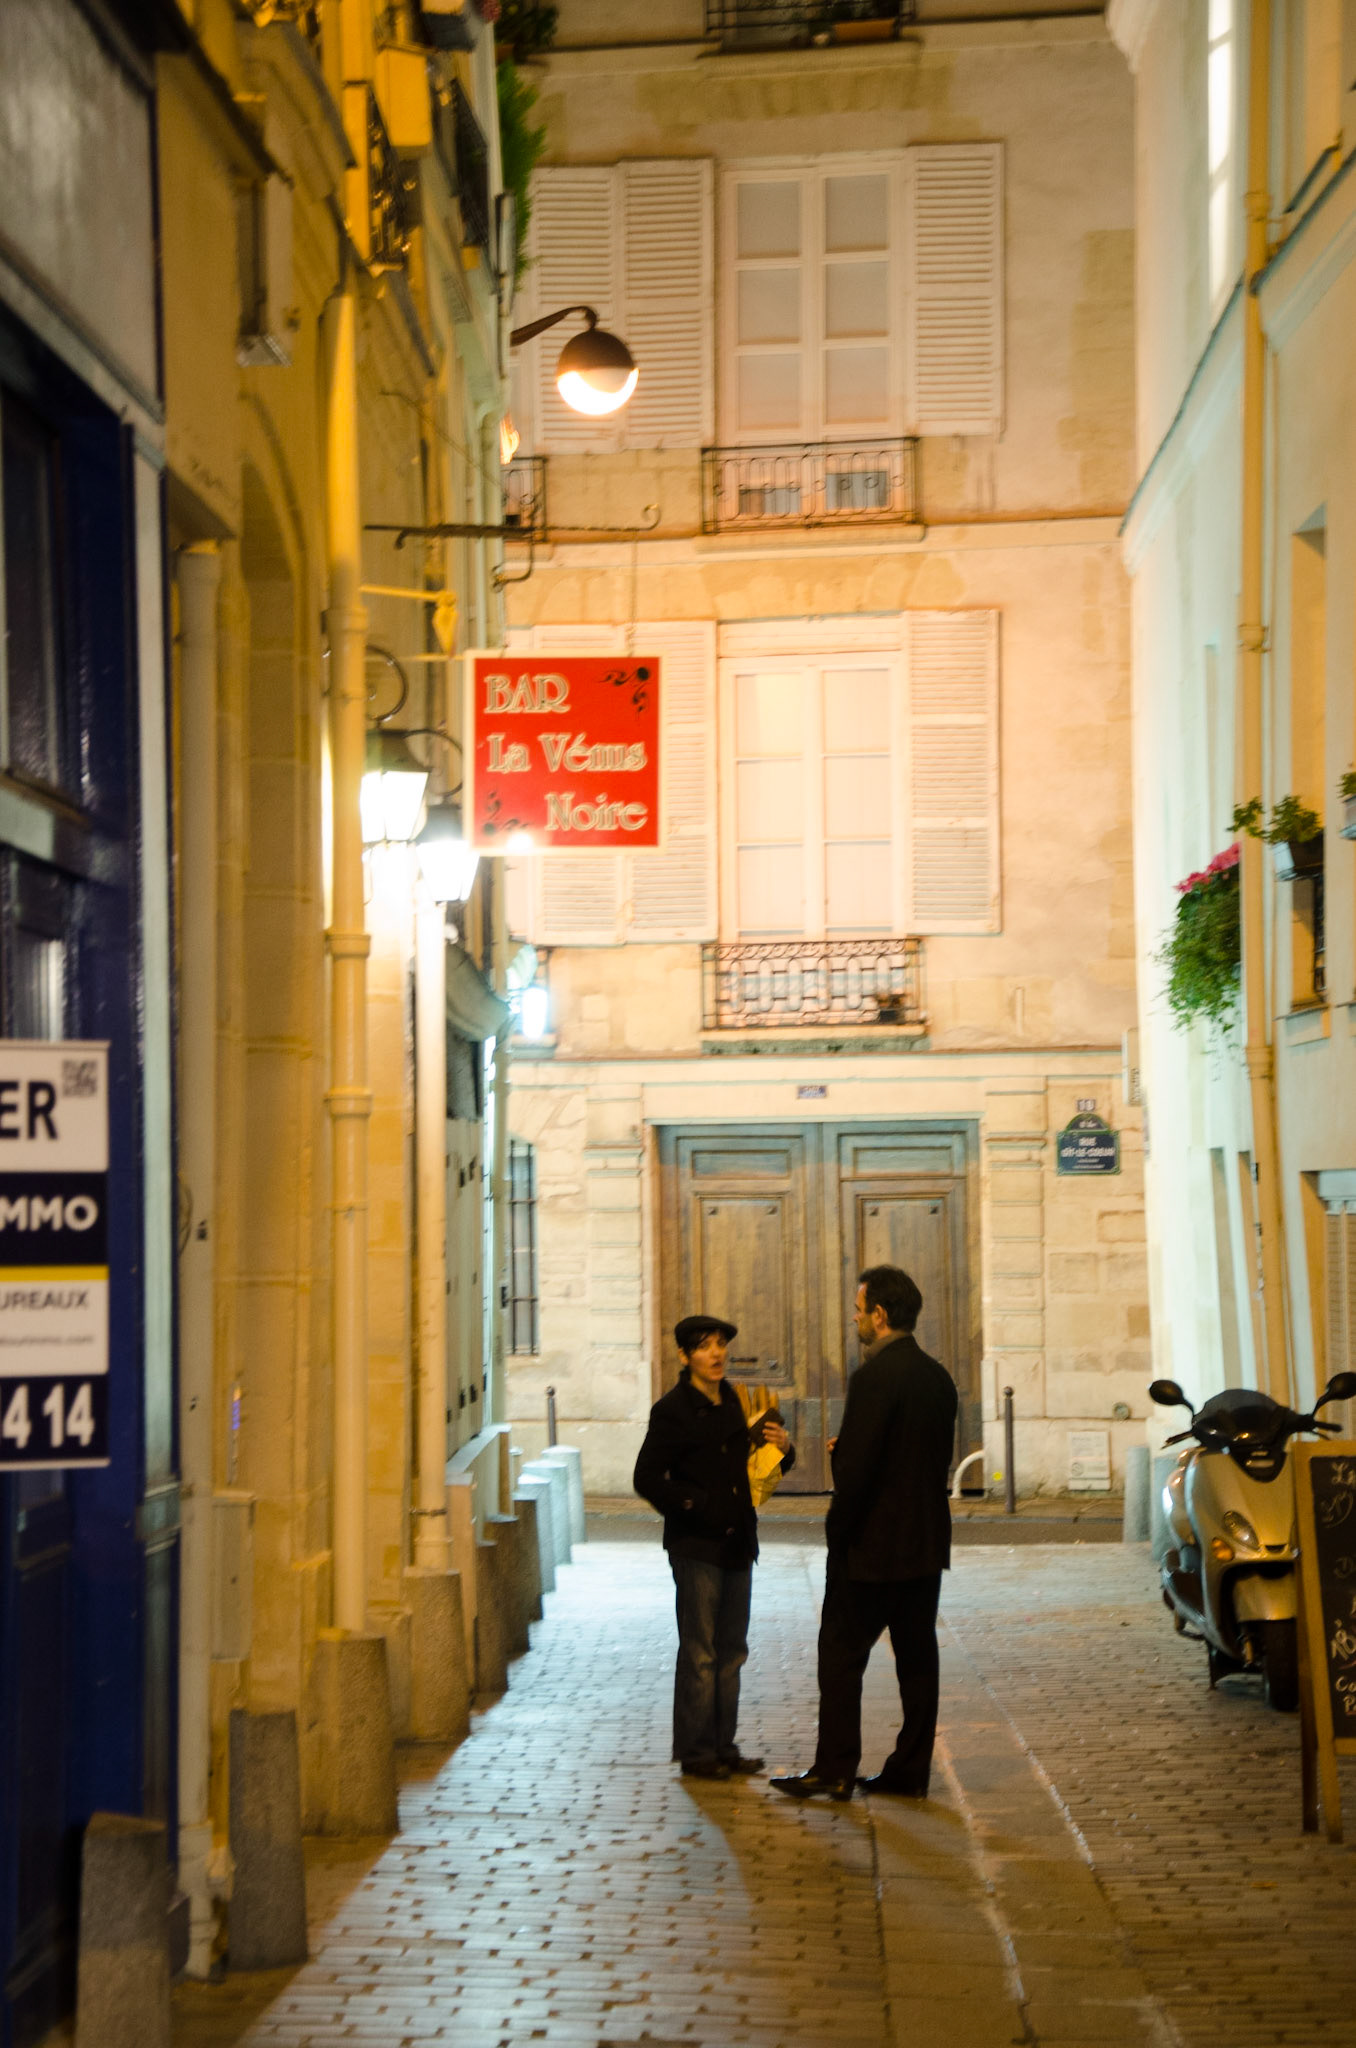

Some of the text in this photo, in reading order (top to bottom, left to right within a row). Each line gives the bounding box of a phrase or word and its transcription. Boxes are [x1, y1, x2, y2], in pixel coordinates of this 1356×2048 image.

[484, 673, 571, 714] BAR
[486, 732, 648, 774] La Vénus
[544, 791, 648, 831] Noire
[42, 1382, 95, 1448] 14
